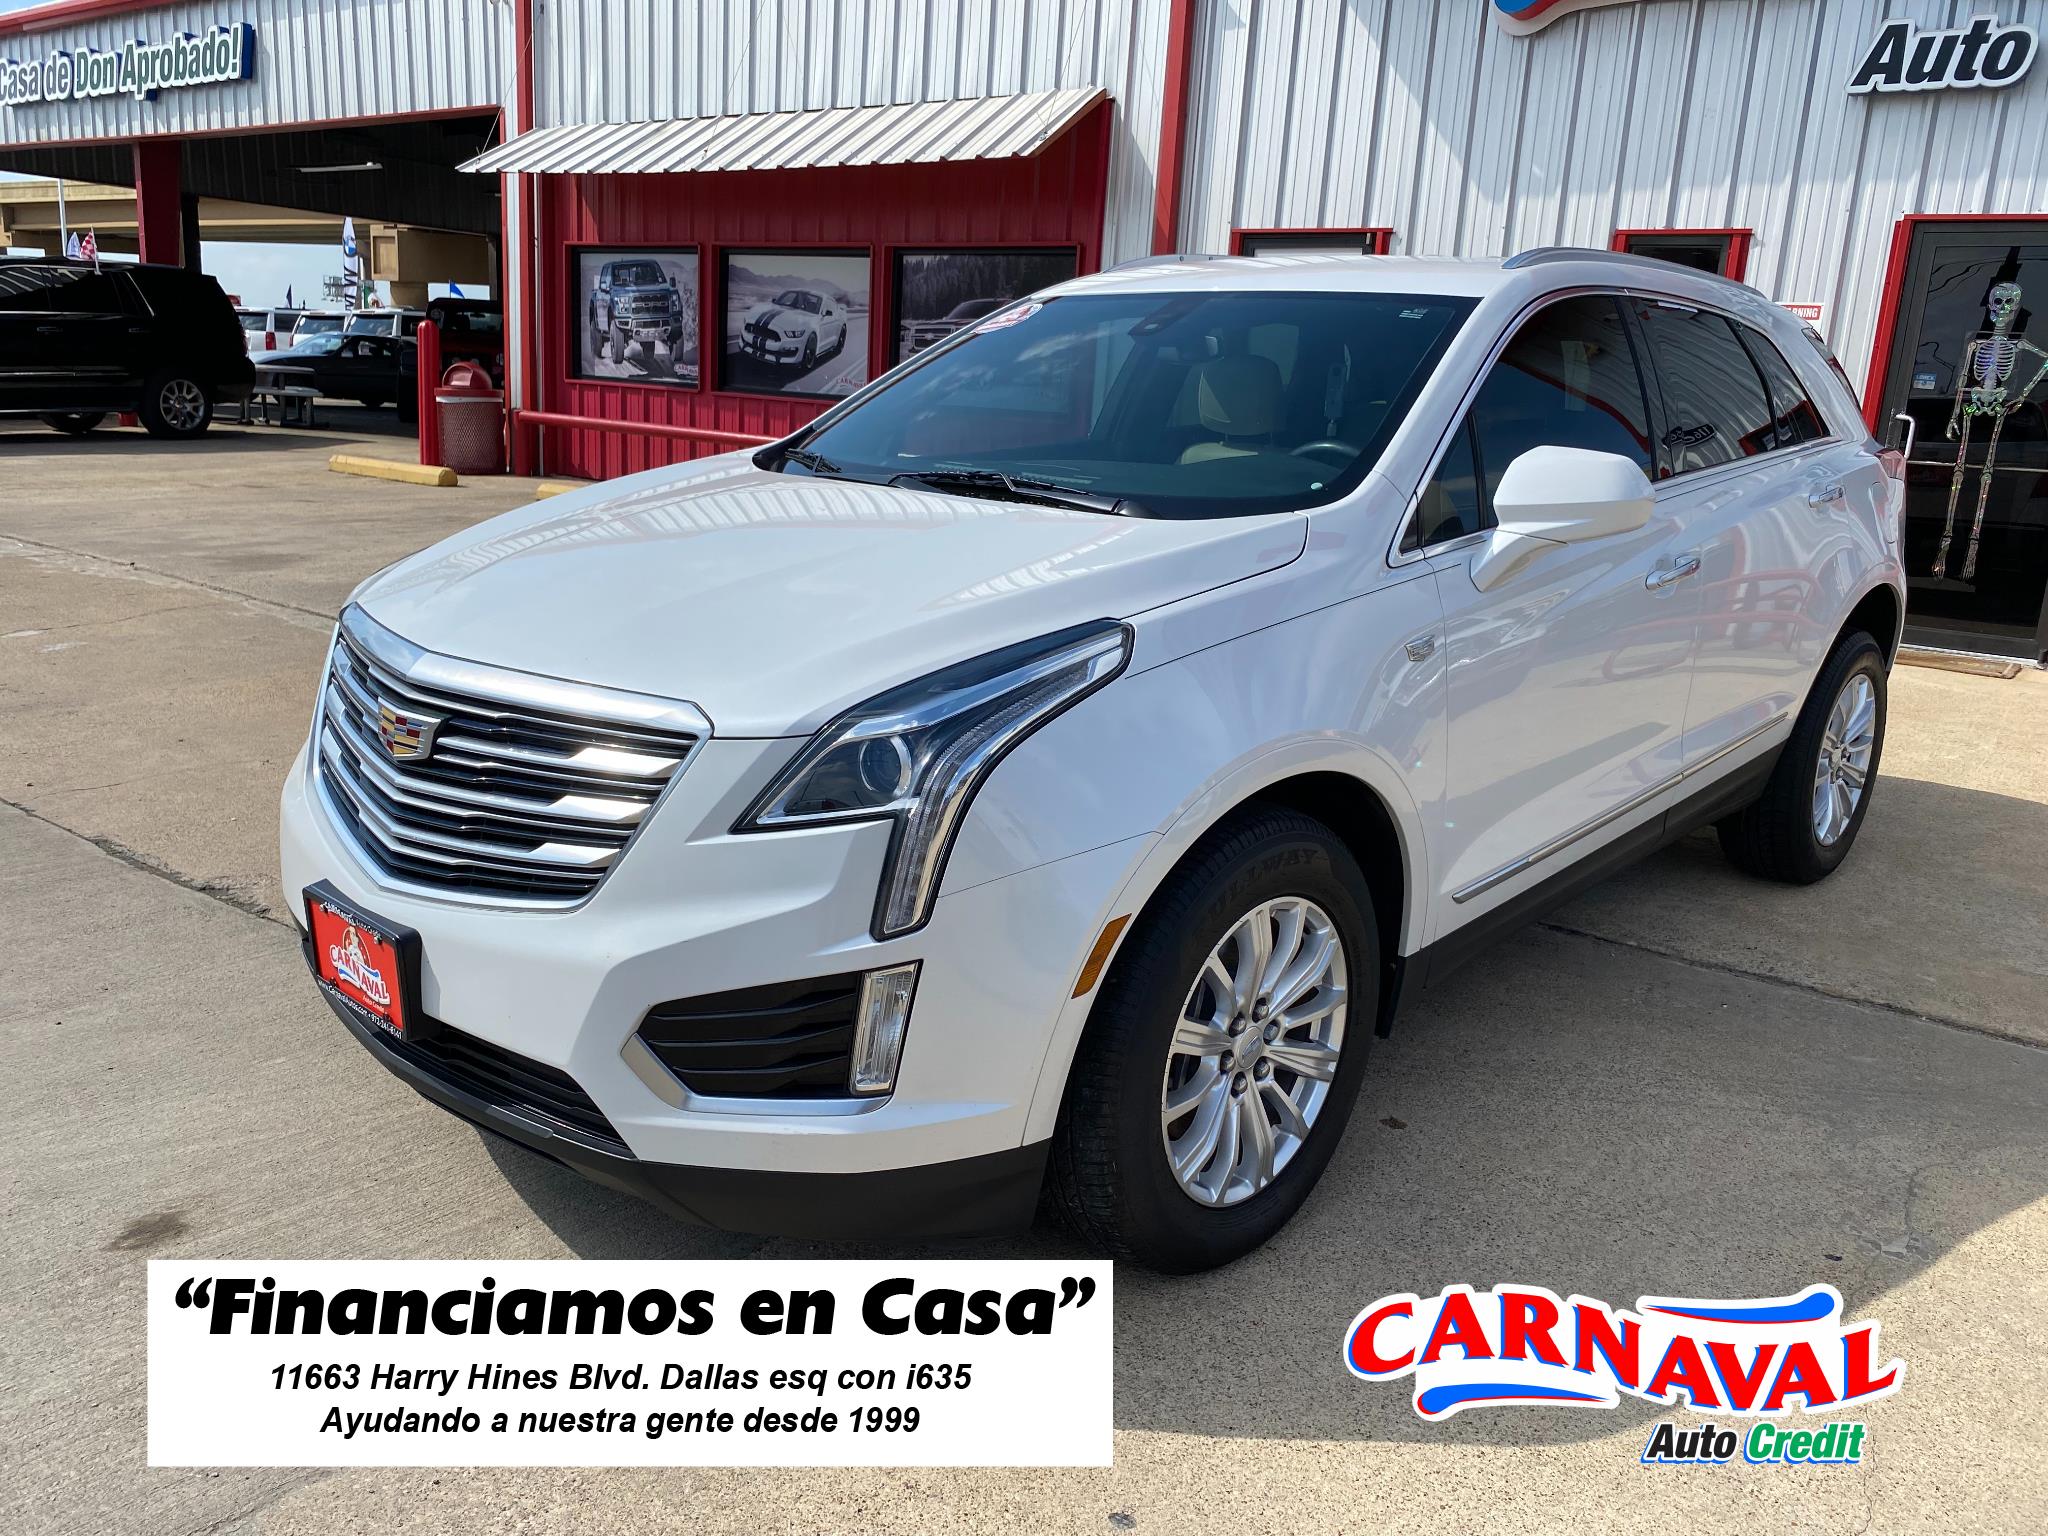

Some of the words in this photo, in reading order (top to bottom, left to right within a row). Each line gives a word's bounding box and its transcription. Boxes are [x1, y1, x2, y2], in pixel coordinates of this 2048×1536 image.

[0, 62, 39, 100] Casa
[46, 55, 69, 96] de
[76, 49, 115, 93] Don
[121, 27, 239, 95] Aprobado!
[1851, 18, 2035, 88] Auto
[330, 945, 390, 1001] CARNAVAL
